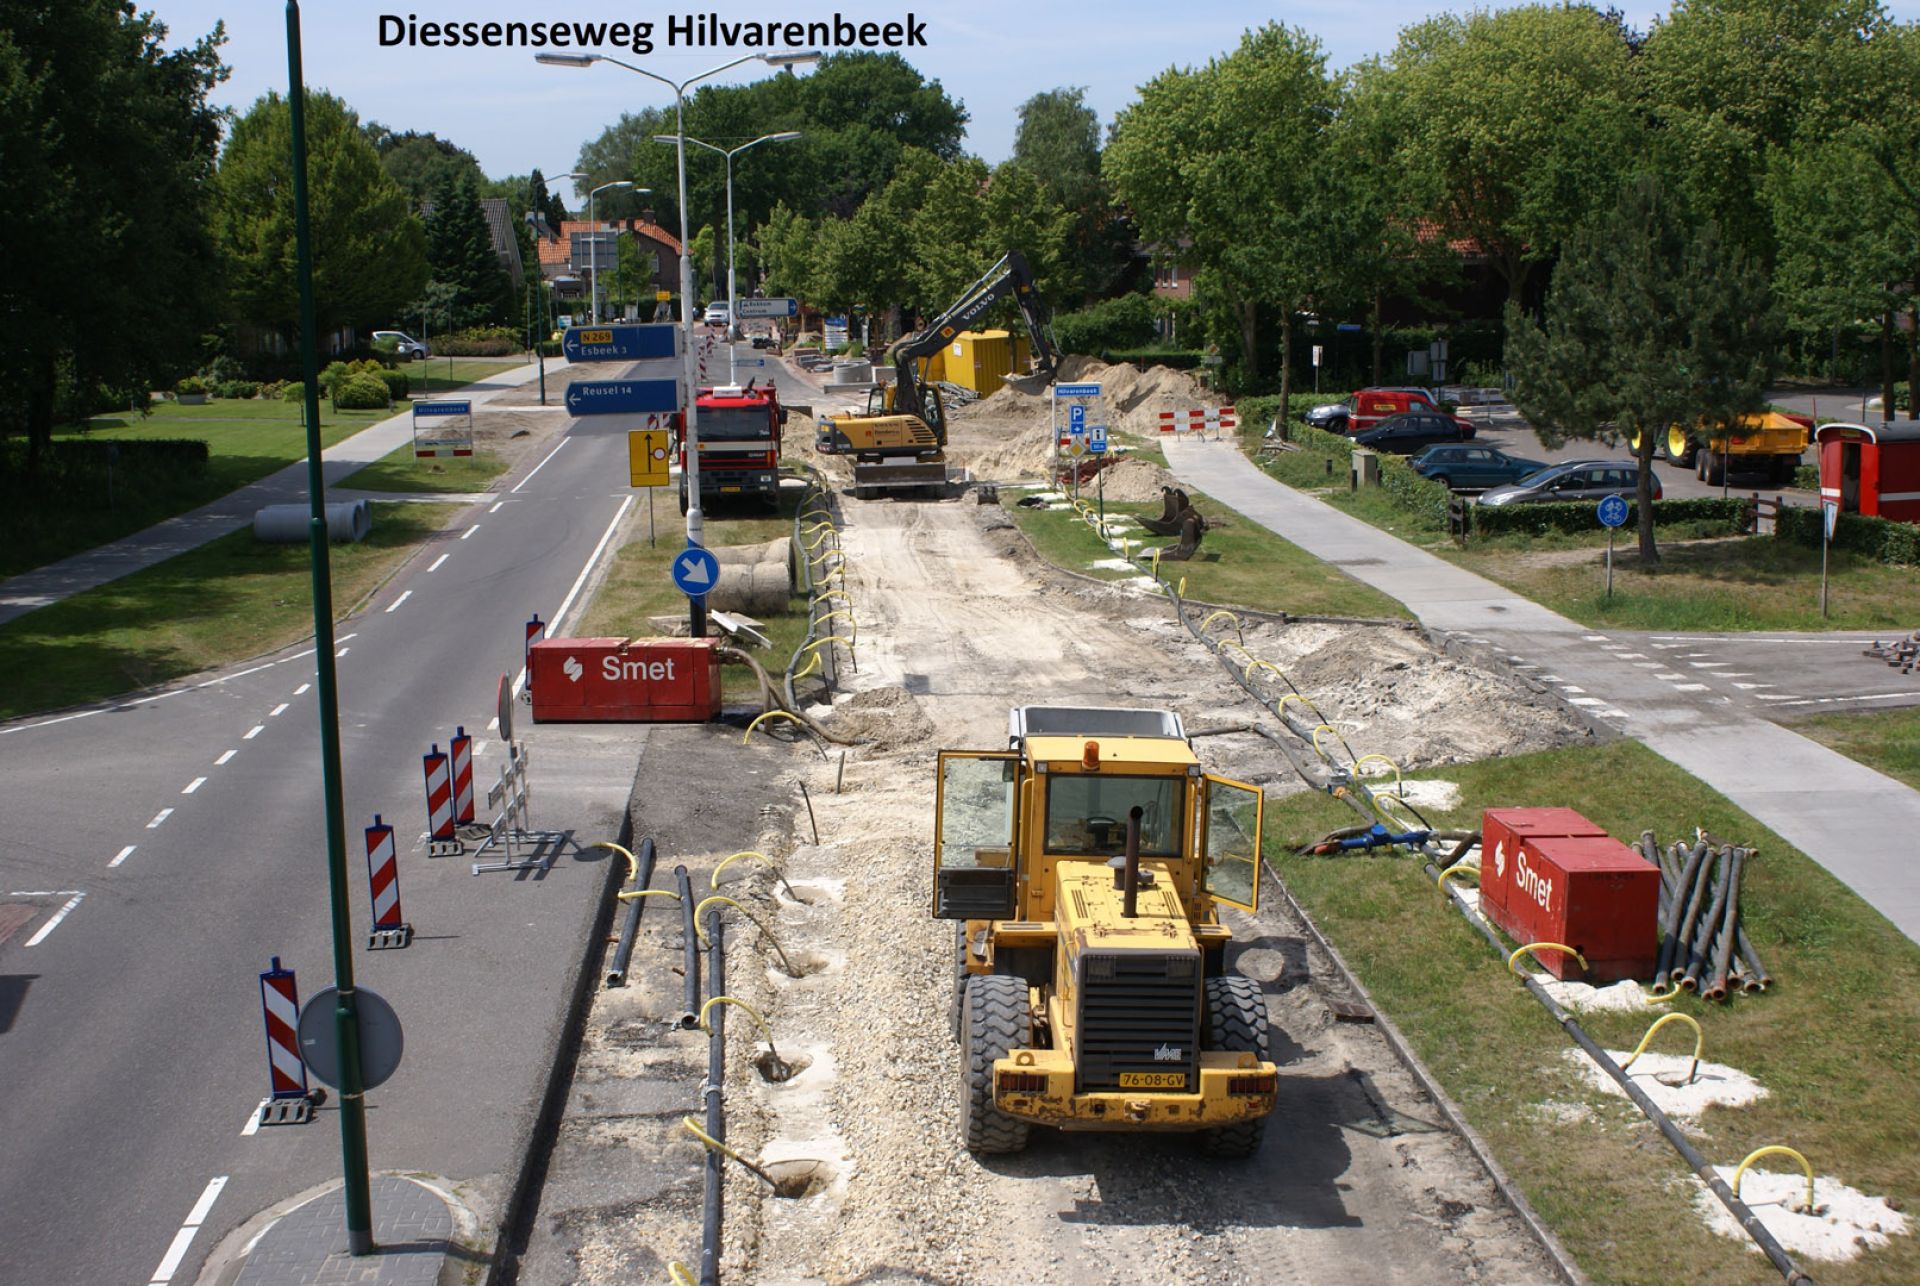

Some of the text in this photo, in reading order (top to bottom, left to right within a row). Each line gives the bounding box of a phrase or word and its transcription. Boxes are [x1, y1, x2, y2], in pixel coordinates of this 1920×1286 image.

[962, 293, 995, 320] VOLVO
[582, 331, 611, 342] N 269
[581, 345, 627, 356] Esbeek 3
[582, 386, 632, 396] Reusel 14
[1073, 407, 1082, 421] P
[602, 655, 675, 681] Smet
[1516, 851, 1553, 913] Smet
[1124, 1074, 1183, 1086] 76-08-GV
